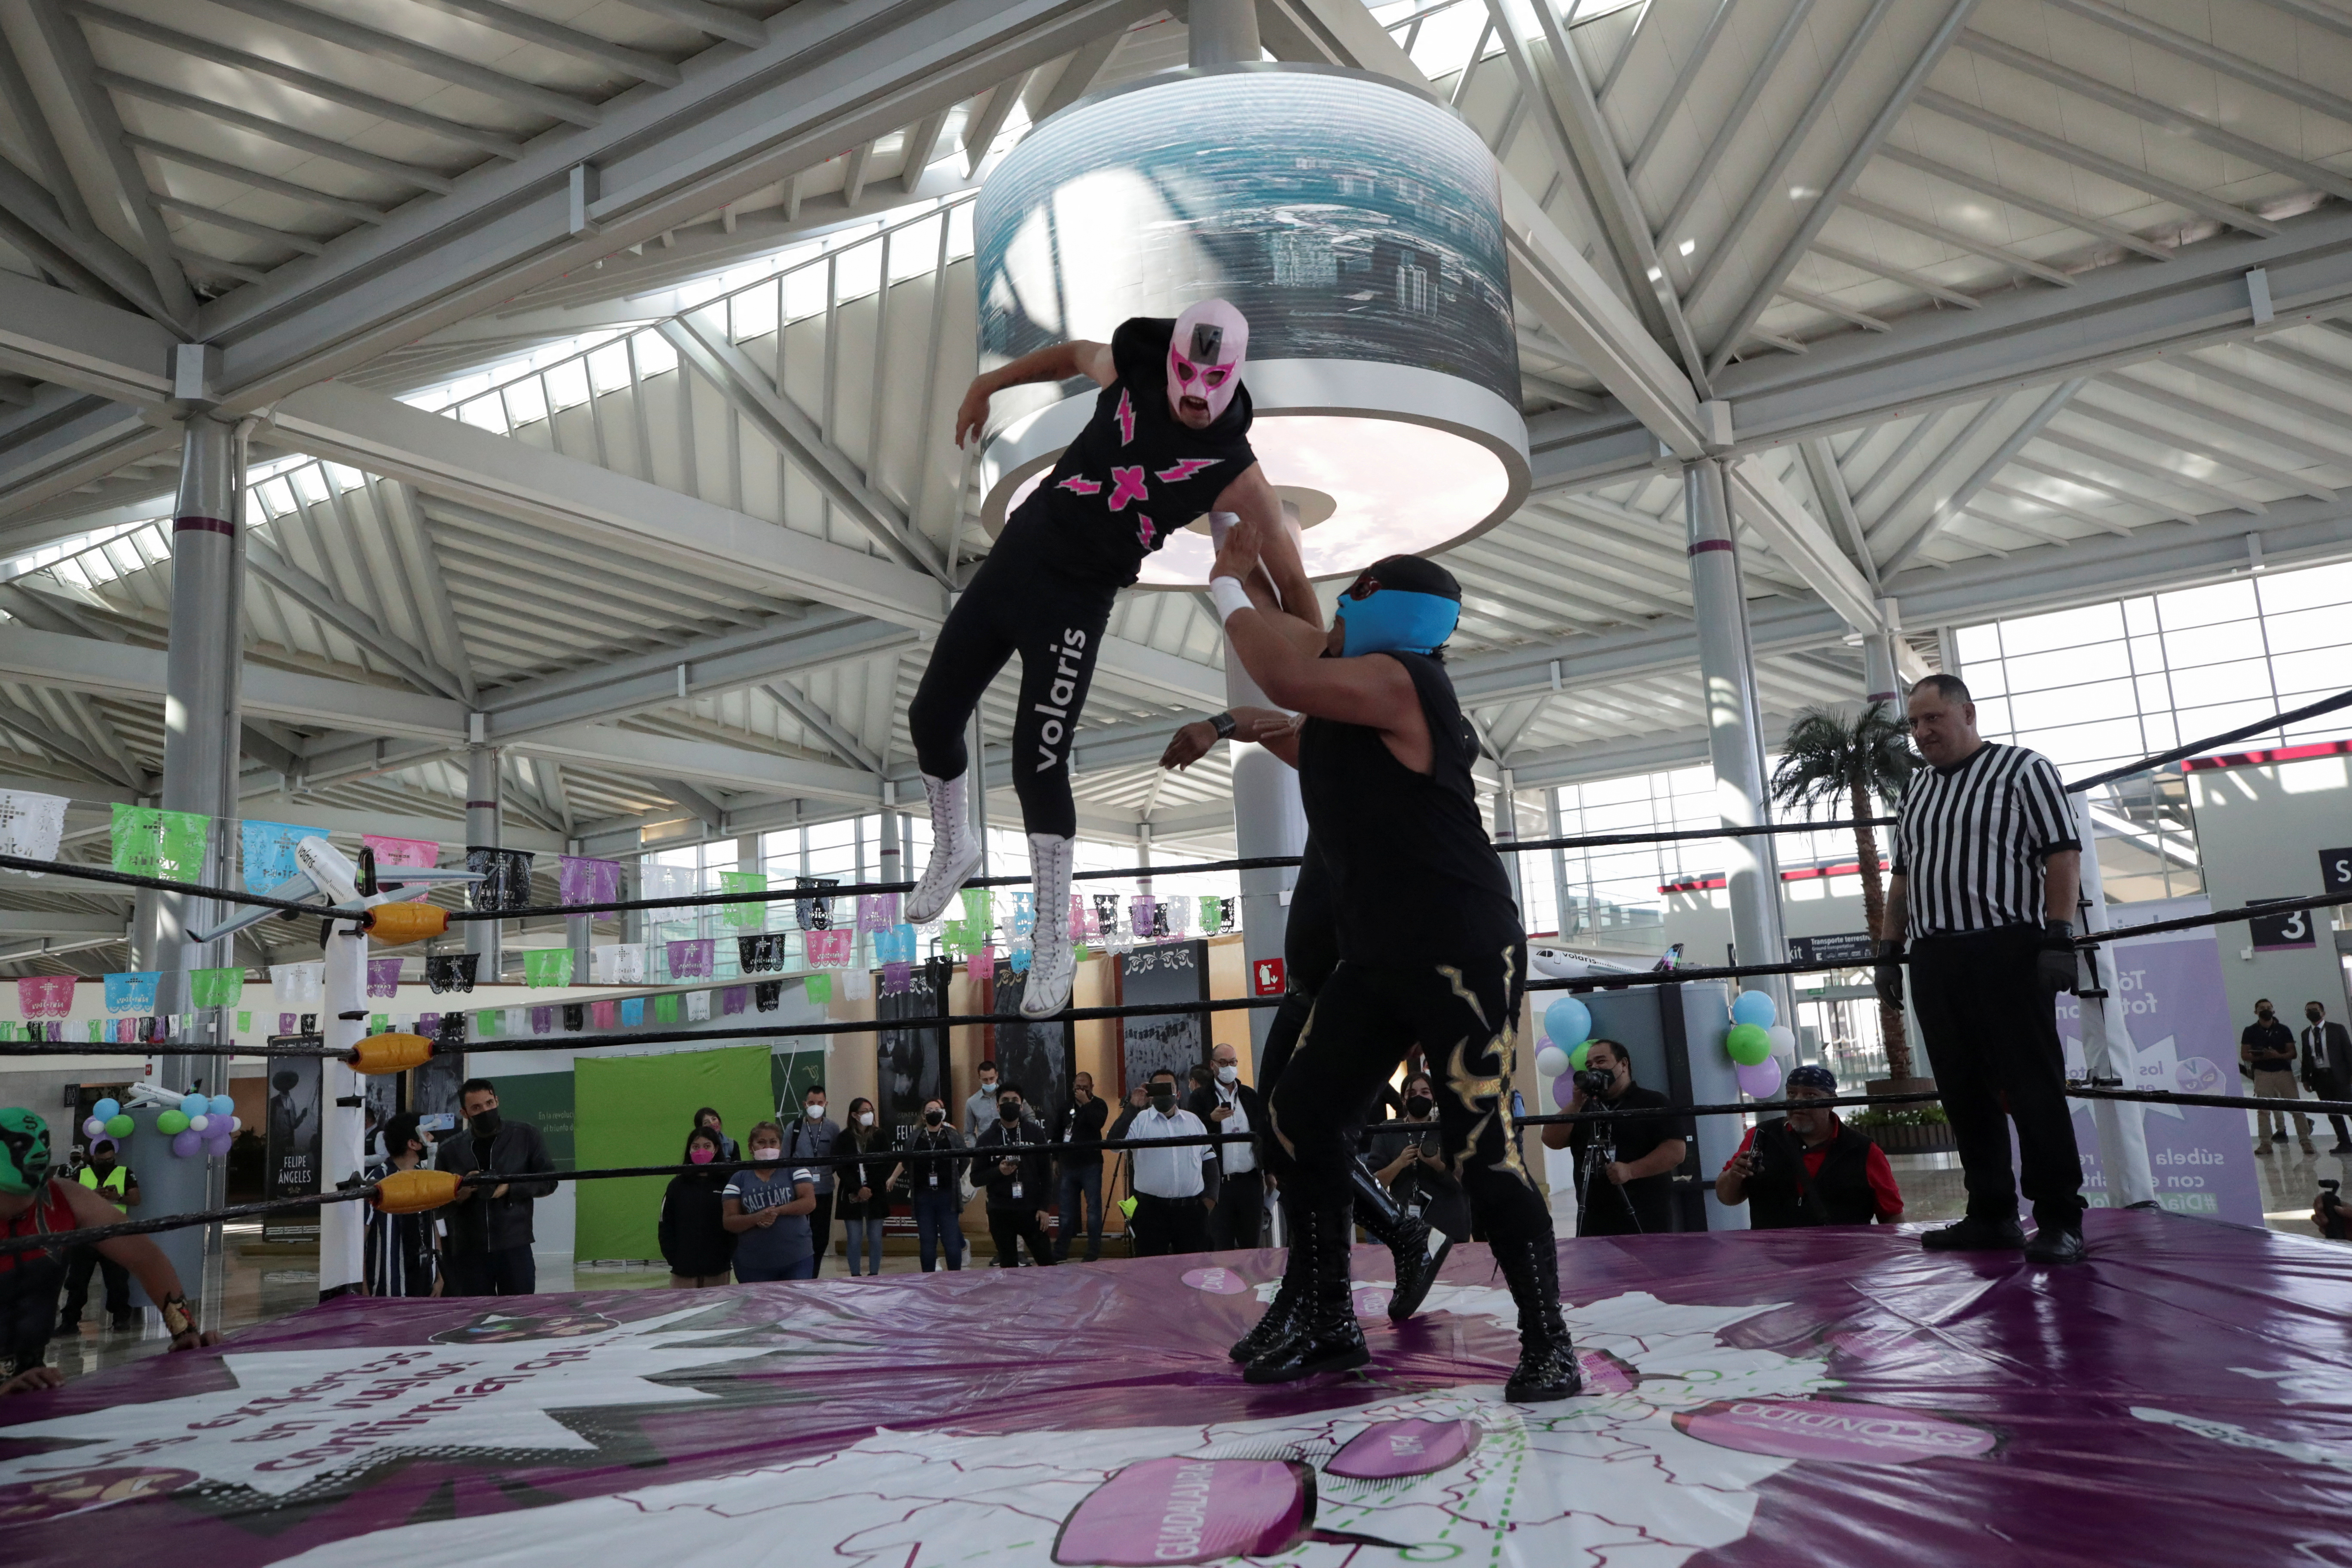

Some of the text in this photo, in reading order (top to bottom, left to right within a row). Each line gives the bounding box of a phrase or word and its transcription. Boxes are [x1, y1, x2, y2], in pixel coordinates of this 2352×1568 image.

[1035, 627, 1086, 773] volaris
[297, 845, 316, 869] volaris
[2281, 910, 2305, 939] 3
[1811, 935, 1844, 945] Transporte
[1562, 952, 1597, 964] volaris
[284, 1155, 306, 1168] FELIPE
[278, 1169, 311, 1184] ÁNGELES
[743, 1187, 791, 1213] SALT LAKE
[1155, 1461, 1215, 1560] GUADALAJARA
